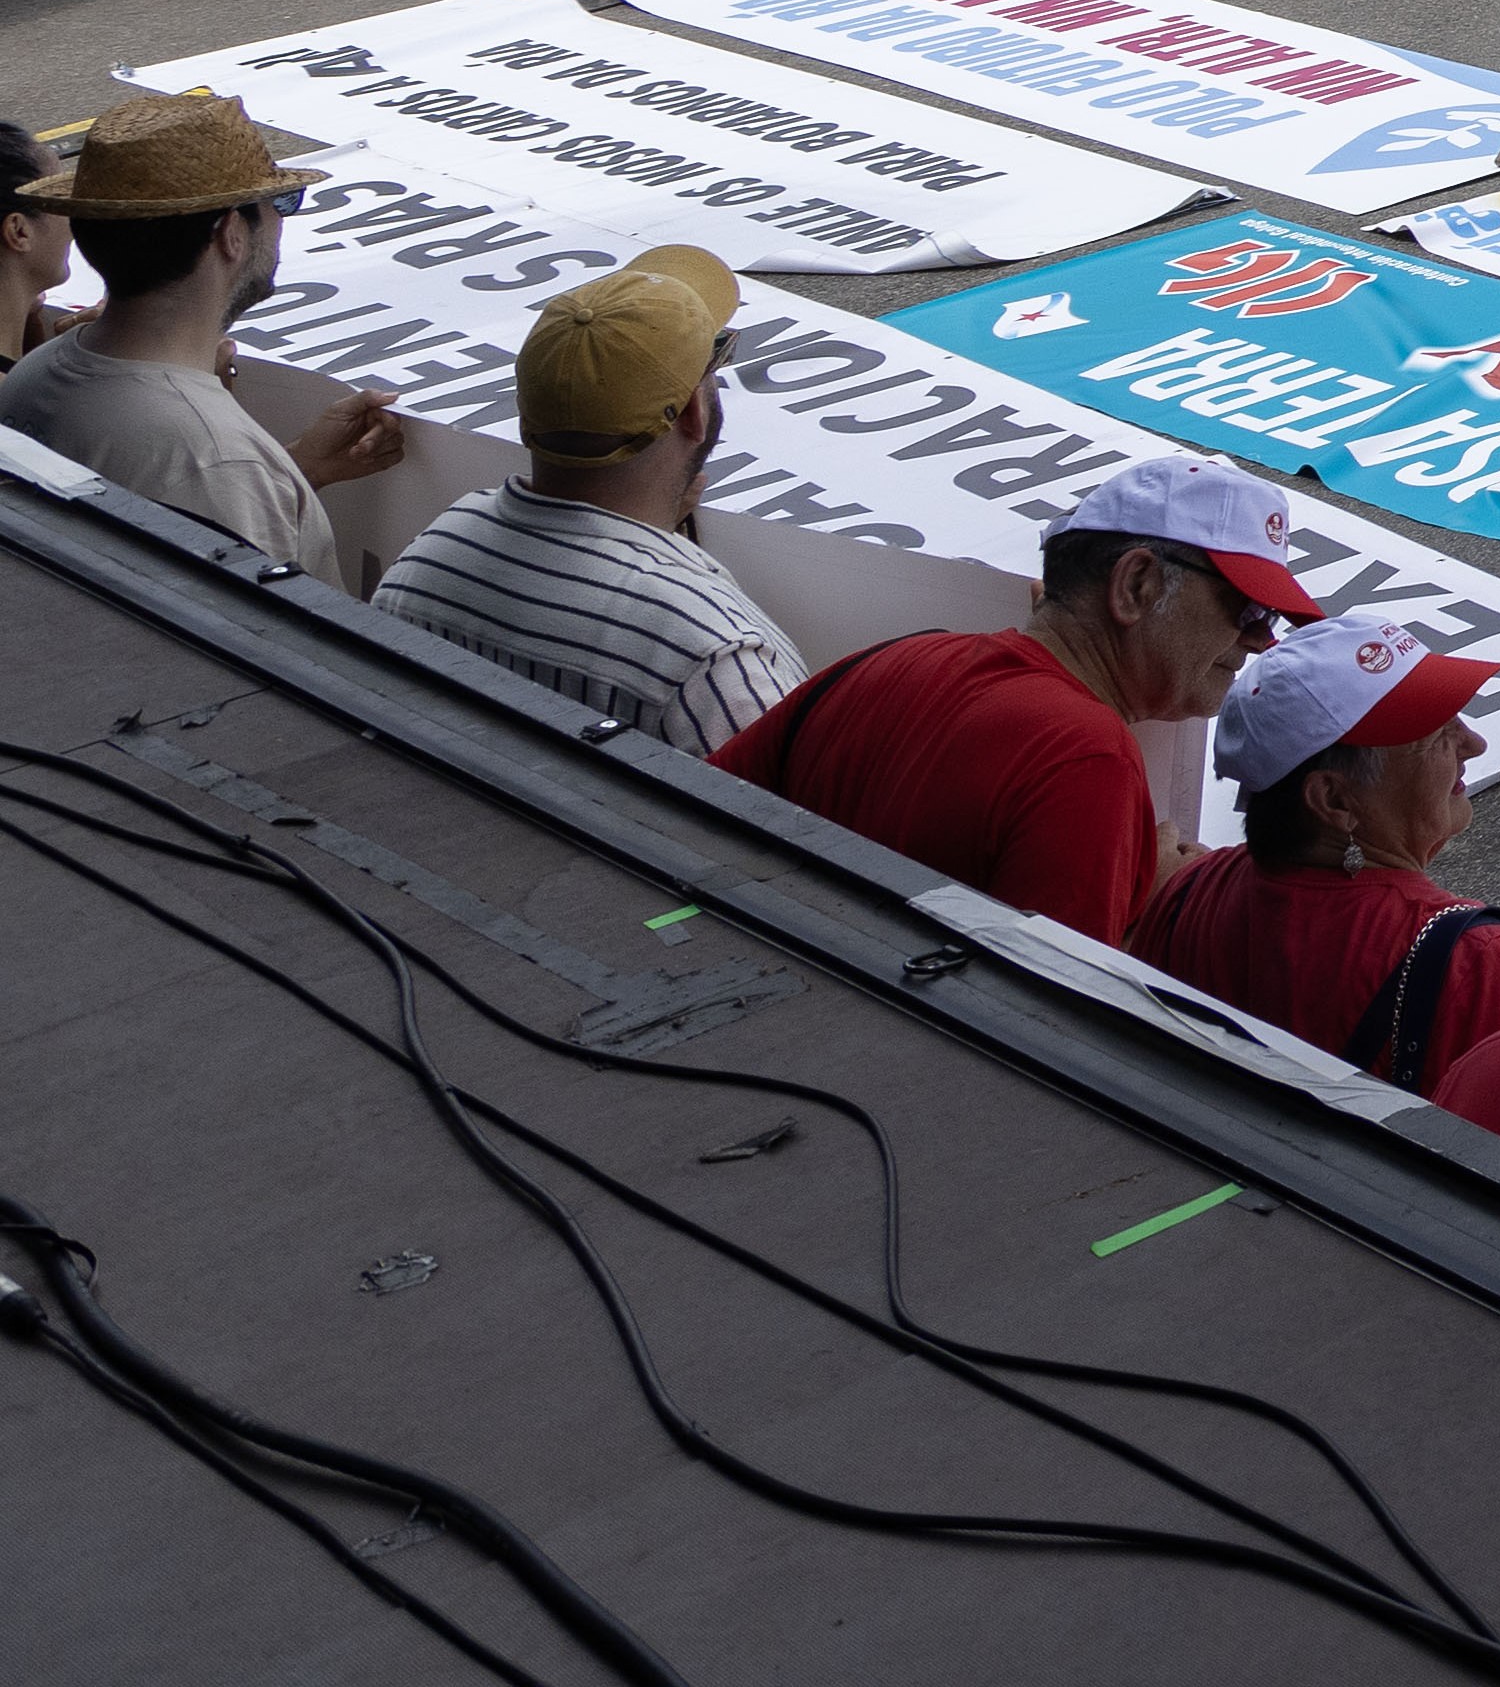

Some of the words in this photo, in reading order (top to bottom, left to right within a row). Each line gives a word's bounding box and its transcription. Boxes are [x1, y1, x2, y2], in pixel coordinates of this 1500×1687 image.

[463, 39, 537, 69] RÍA
[846, 0, 949, 55] DA
[1098, 15, 1314, 78] ALTRI,
[339, 74, 425, 98] A
[543, 58, 629, 89] DA
[891, 24, 1156, 100] FUTURO
[1280, 50, 1420, 106] NIN
[375, 87, 571, 143] CARTOS
[605, 79, 876, 153] BOTARNOS
[1087, 69, 1308, 139] POLO
[527, 135, 723, 188] NOSOS
[837, 140, 1009, 192] PARA
[674, 175, 788, 209] OS
[1239, 218, 1291, 237] Galega
[1160, 241, 1375, 321] CIG
[1368, 254, 1471, 288] Confederación
[1079, 325, 1392, 451] TERRA
